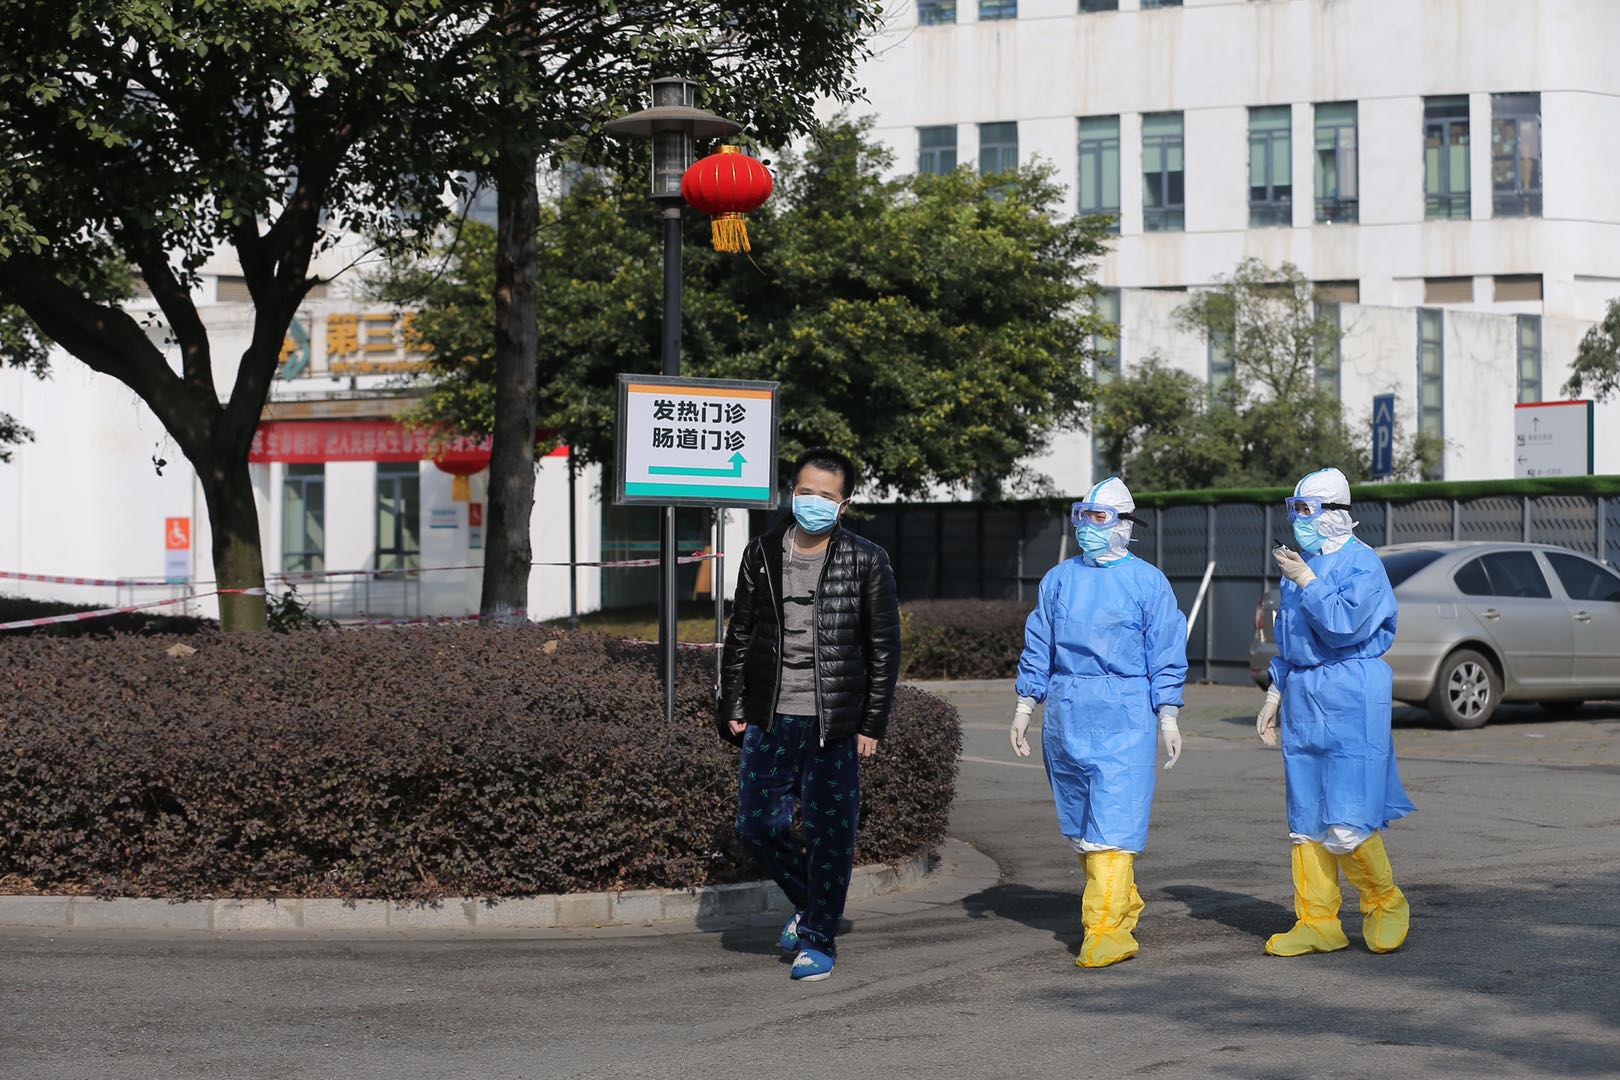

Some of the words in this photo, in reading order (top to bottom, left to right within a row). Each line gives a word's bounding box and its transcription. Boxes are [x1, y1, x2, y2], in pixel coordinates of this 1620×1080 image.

[653, 399, 747, 424] 发热门诊
[652, 427, 746, 451] 肠道门诊
[1376, 426, 1389, 470] P
